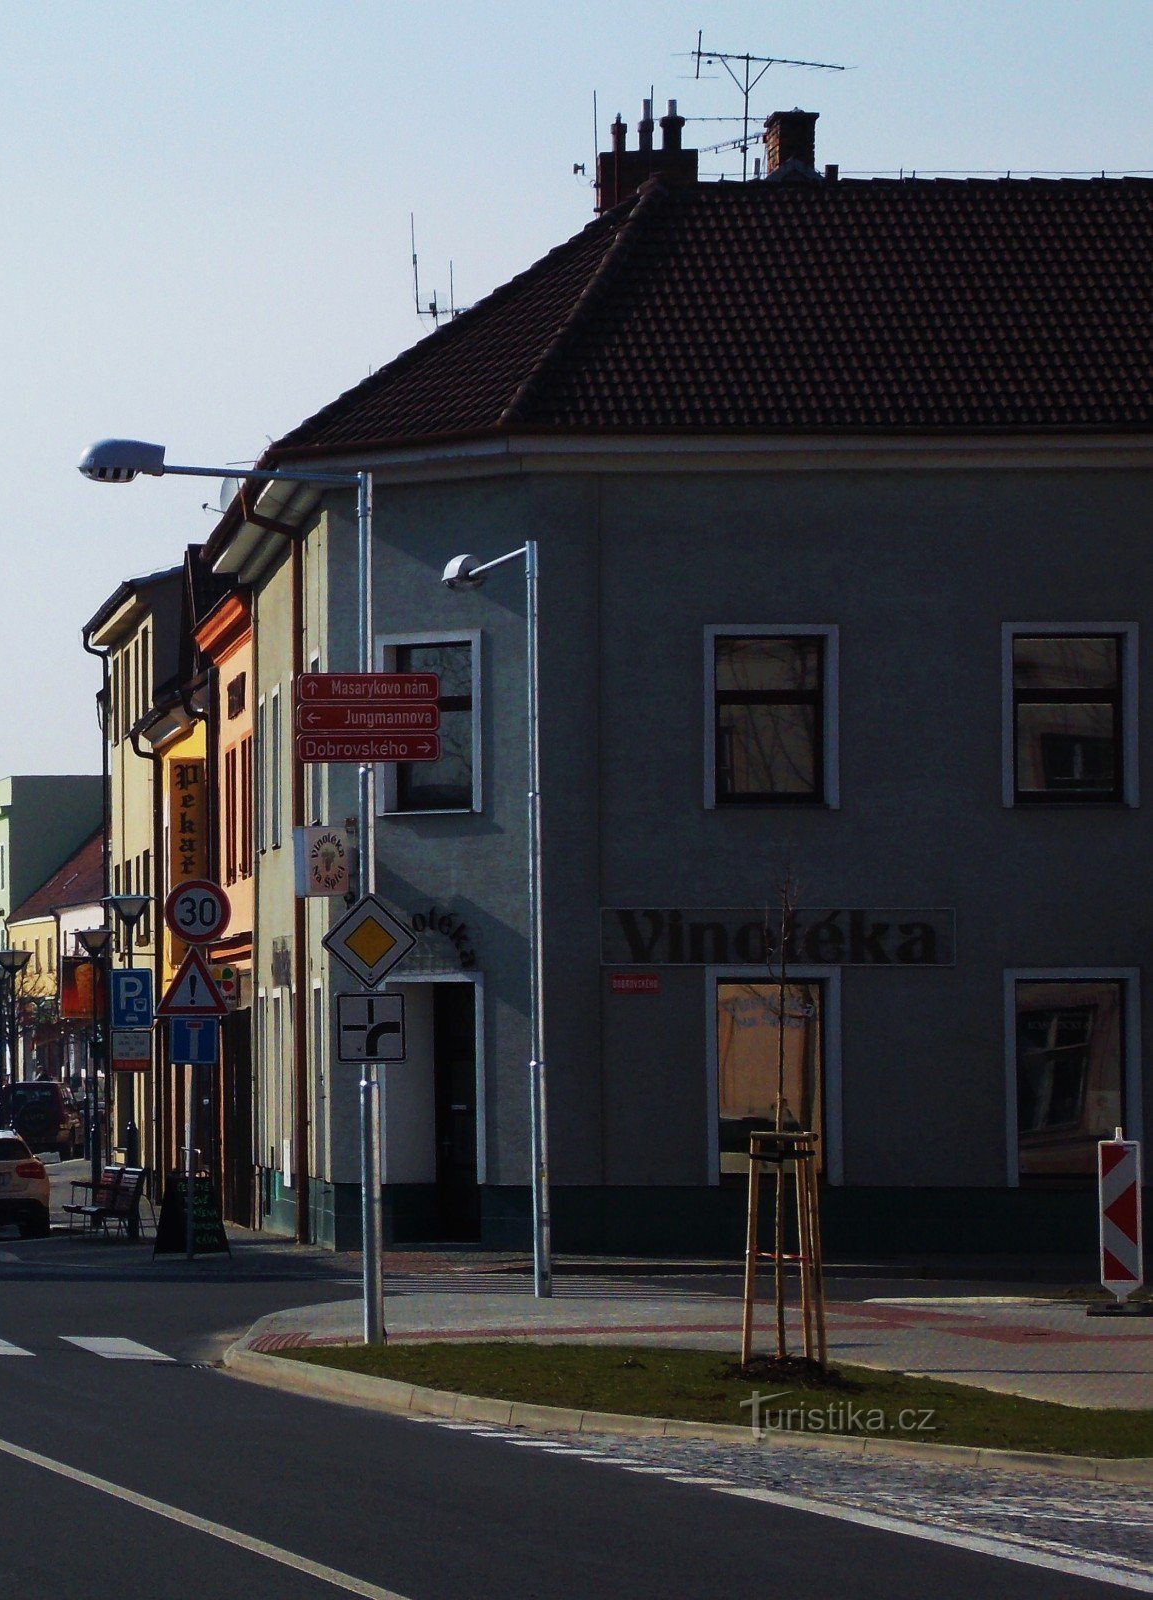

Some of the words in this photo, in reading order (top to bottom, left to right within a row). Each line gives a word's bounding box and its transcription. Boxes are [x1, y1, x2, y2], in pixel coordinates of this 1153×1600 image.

[331, 680, 401, 698] Masarykovo
[404, 679, 433, 696] nám.
[344, 709, 432, 728] Jungmannova
[305, 739, 408, 757] Dobrovského
[179, 896, 217, 927] 30
[615, 908, 937, 964] Vinotéka
[119, 976, 143, 1010] P
